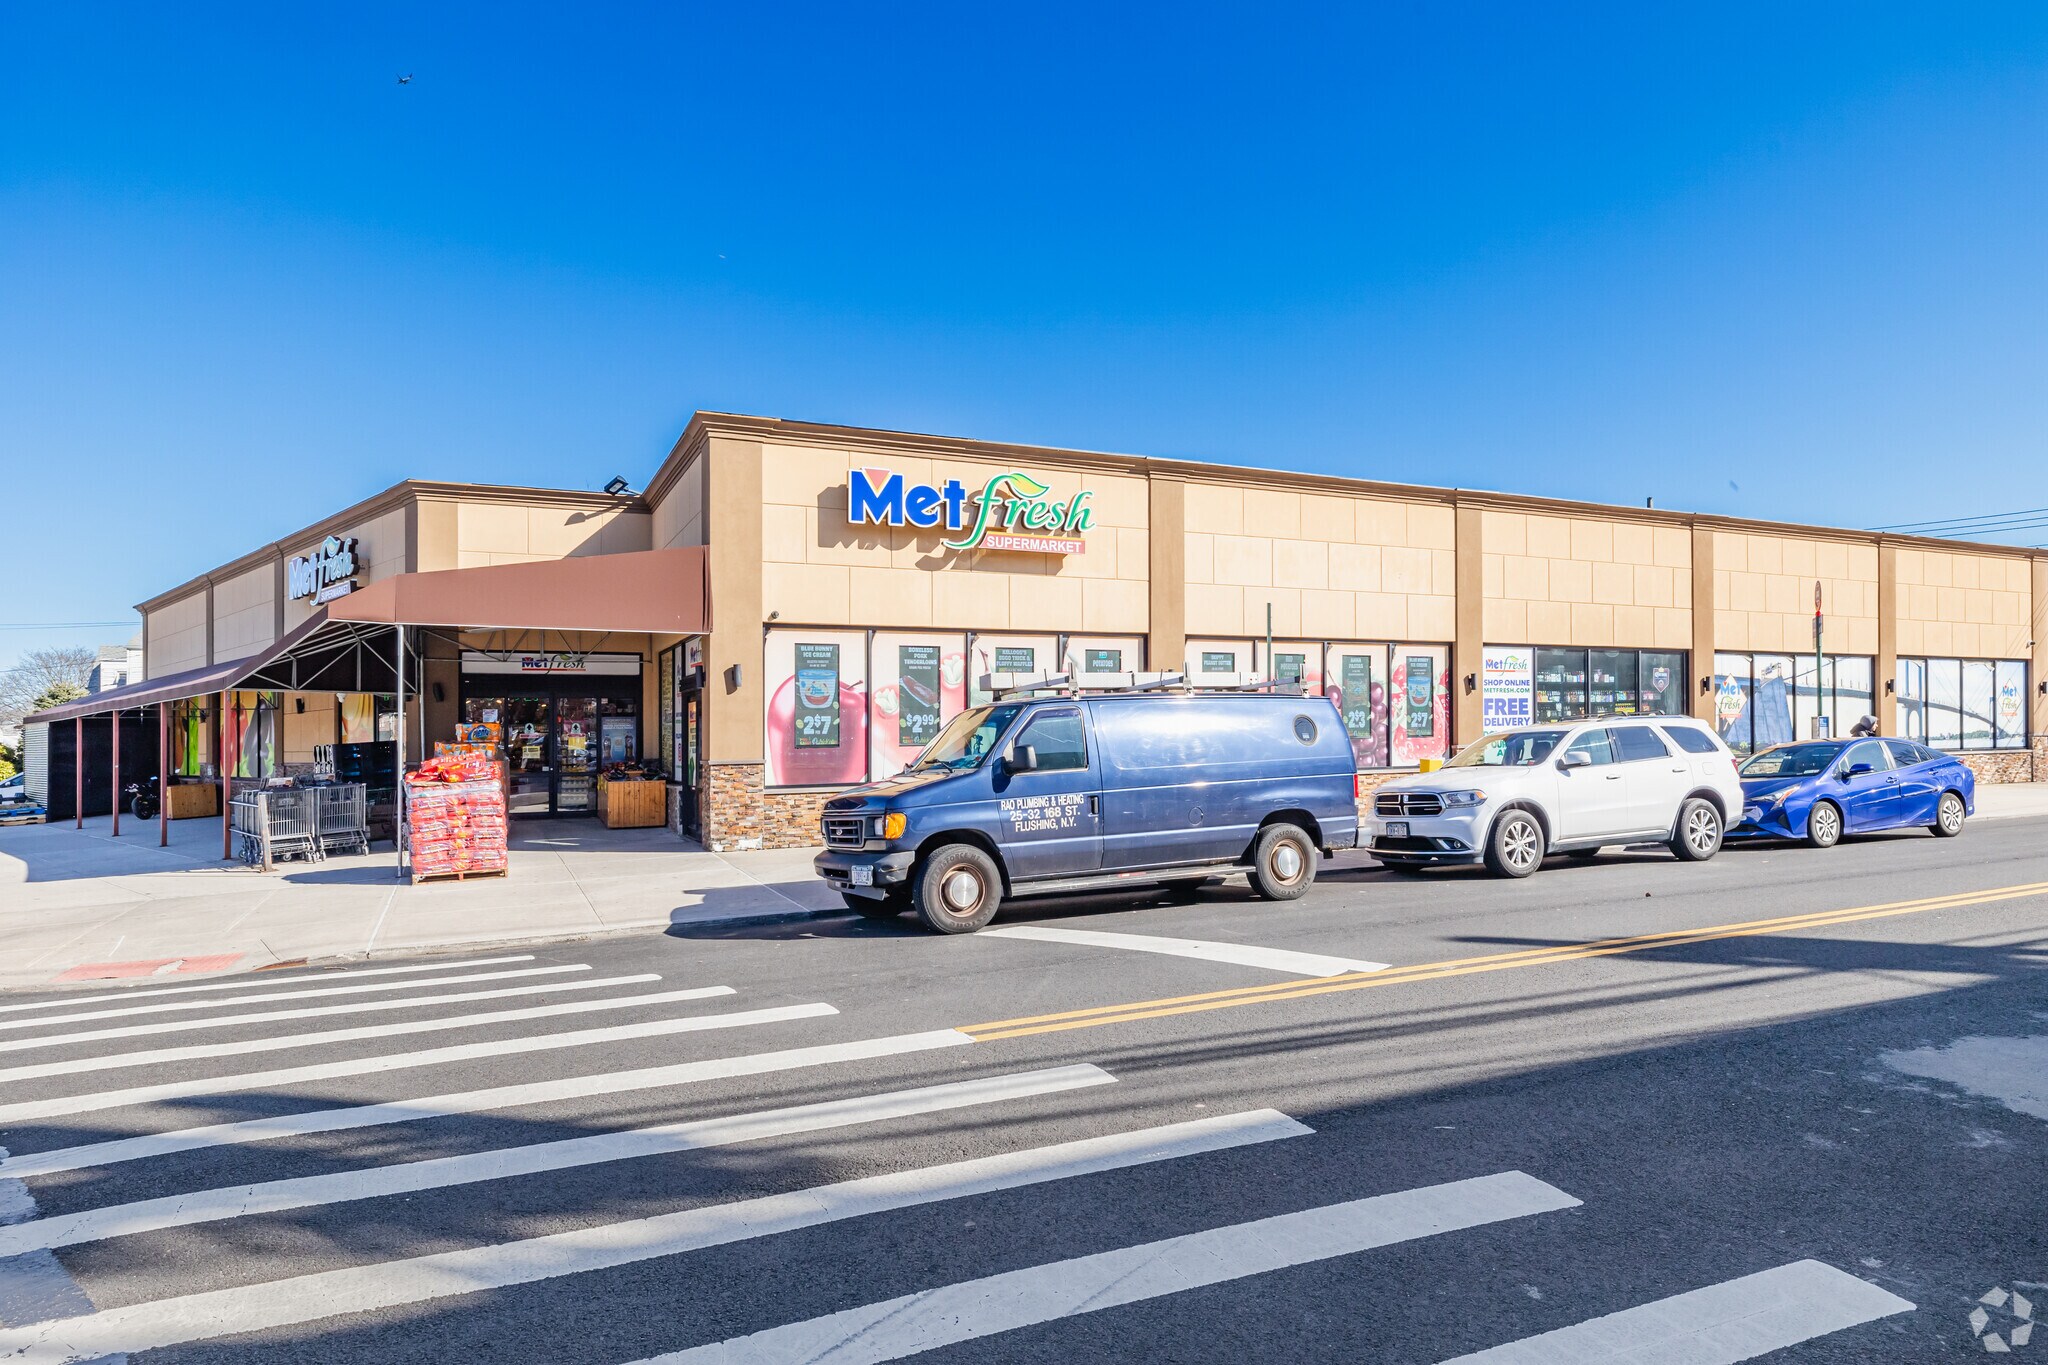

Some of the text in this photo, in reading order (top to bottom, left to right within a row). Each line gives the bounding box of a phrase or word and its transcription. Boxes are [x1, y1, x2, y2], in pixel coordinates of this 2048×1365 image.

[848, 468, 1096, 550] Met fresh
[986, 535, 1082, 553] SUPERMARKET
[288, 536, 355, 606] Met fresh
[1485, 655, 1528, 676] Met fresh
[1484, 698, 1529, 716] FREE
[1484, 717, 1531, 727] DELIVERY
[1001, 793, 1085, 811] RAO PLUMBING & HEATING
[1009, 805, 1081, 822] 25-32 168 ST.
[1015, 816, 1077, 832] FLUSHING, N.Y.
